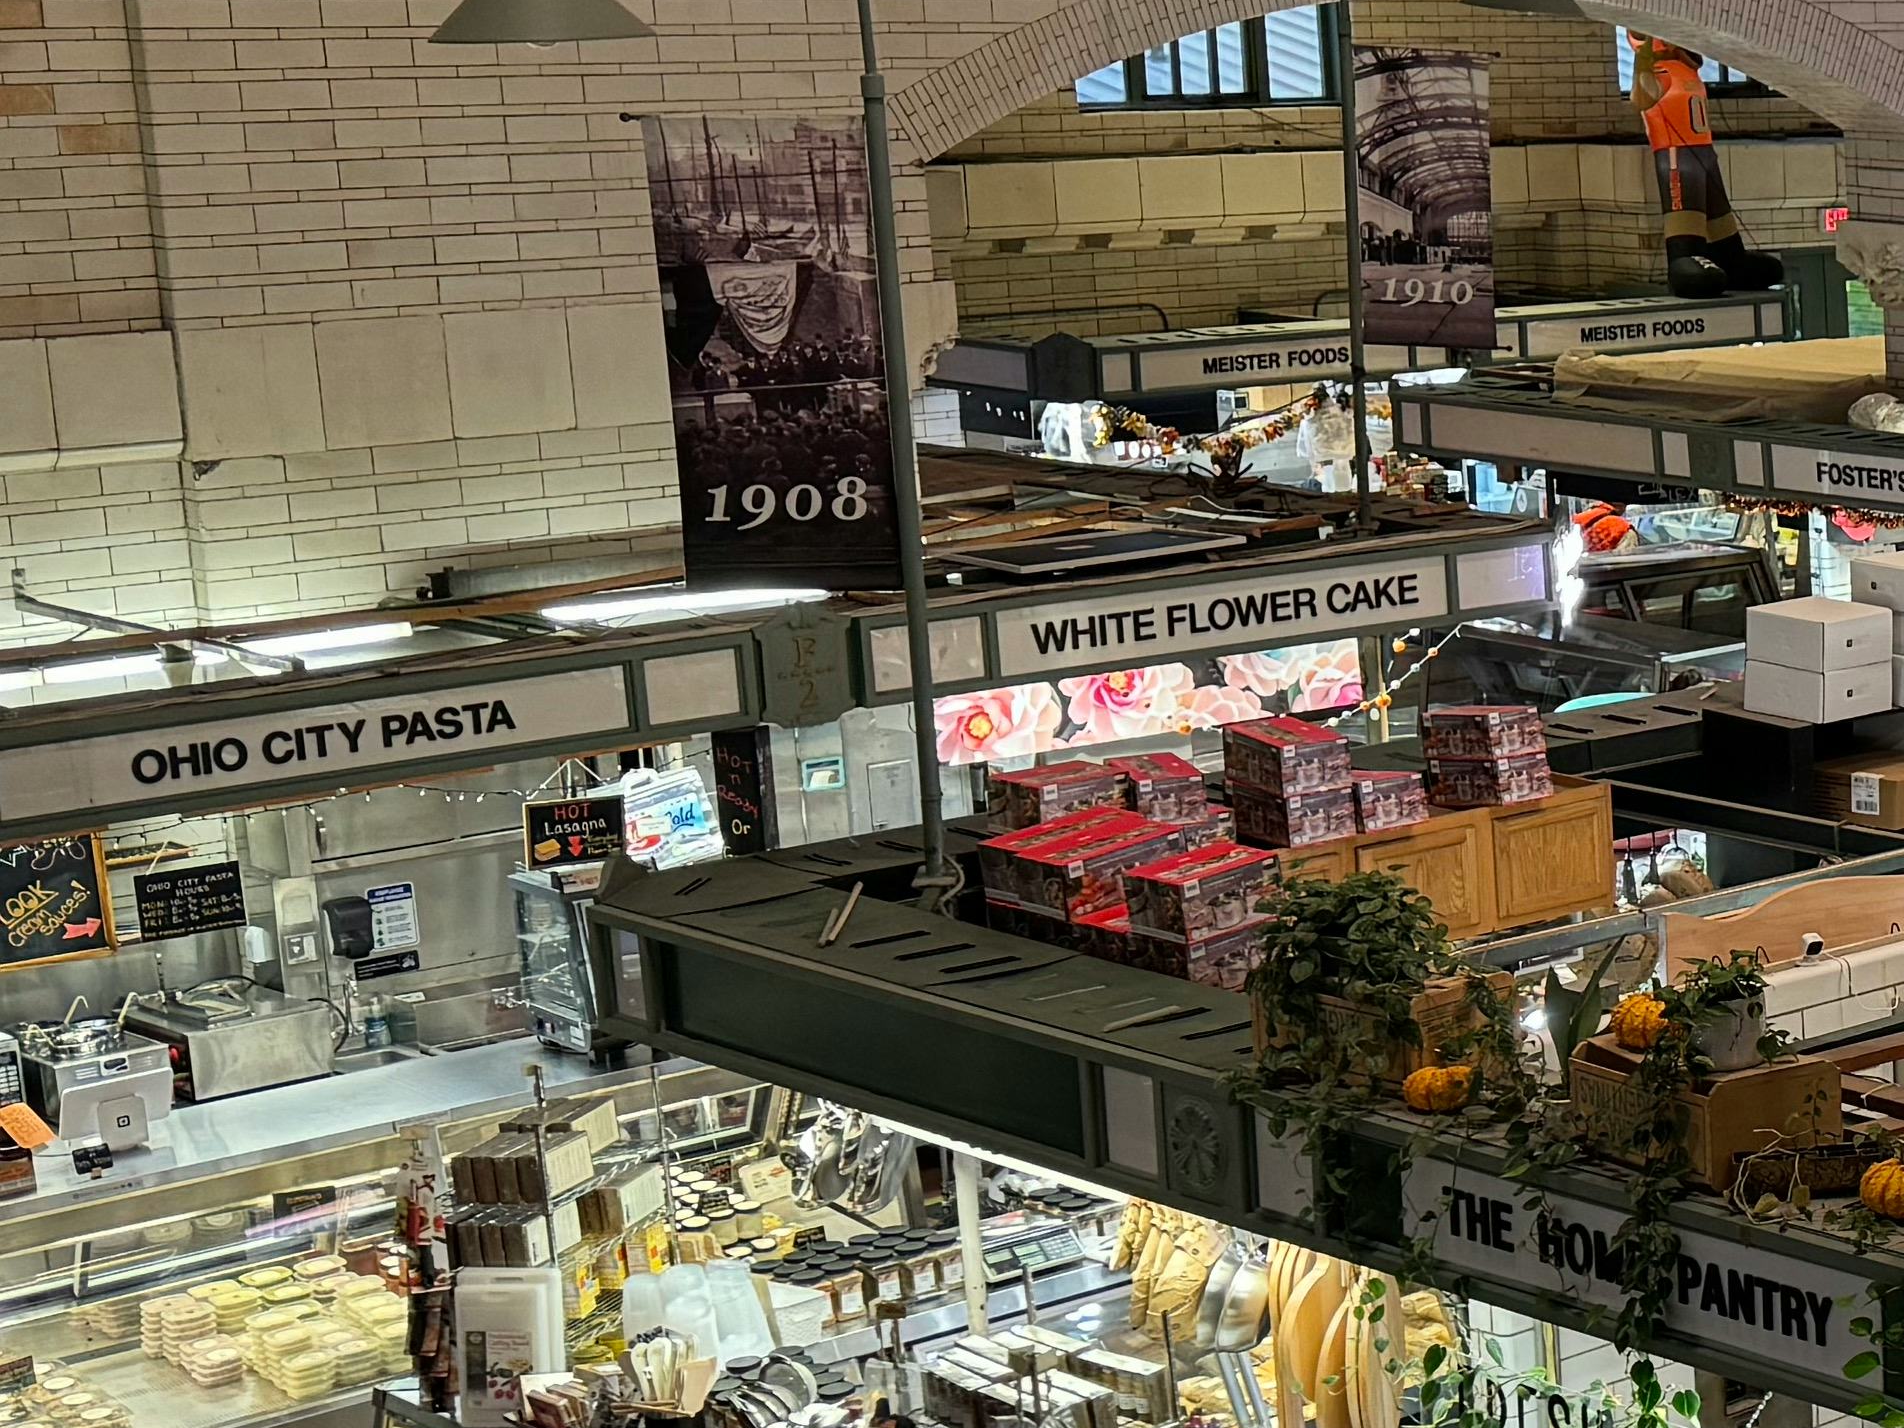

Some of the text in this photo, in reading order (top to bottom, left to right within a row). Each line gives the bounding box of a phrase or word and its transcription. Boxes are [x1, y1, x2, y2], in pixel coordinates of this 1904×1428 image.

[1381, 277, 1475, 308] 1910
[1579, 317, 1706, 344] MEISTER FOODS
[1202, 345, 1350, 375] MEISTER FOODS
[703, 476, 869, 532] 1908
[1030, 572, 1420, 655] WHITE FLOWER CAKE
[131, 698, 518, 787] OHIO CITY PASTA
[543, 816, 608, 840] Lasagna
[553, 801, 592, 822] HOT
[8, 908, 52, 948] cream
[1441, 1185, 1516, 1253] THE
[1677, 1253, 1833, 1347] PANTRY
